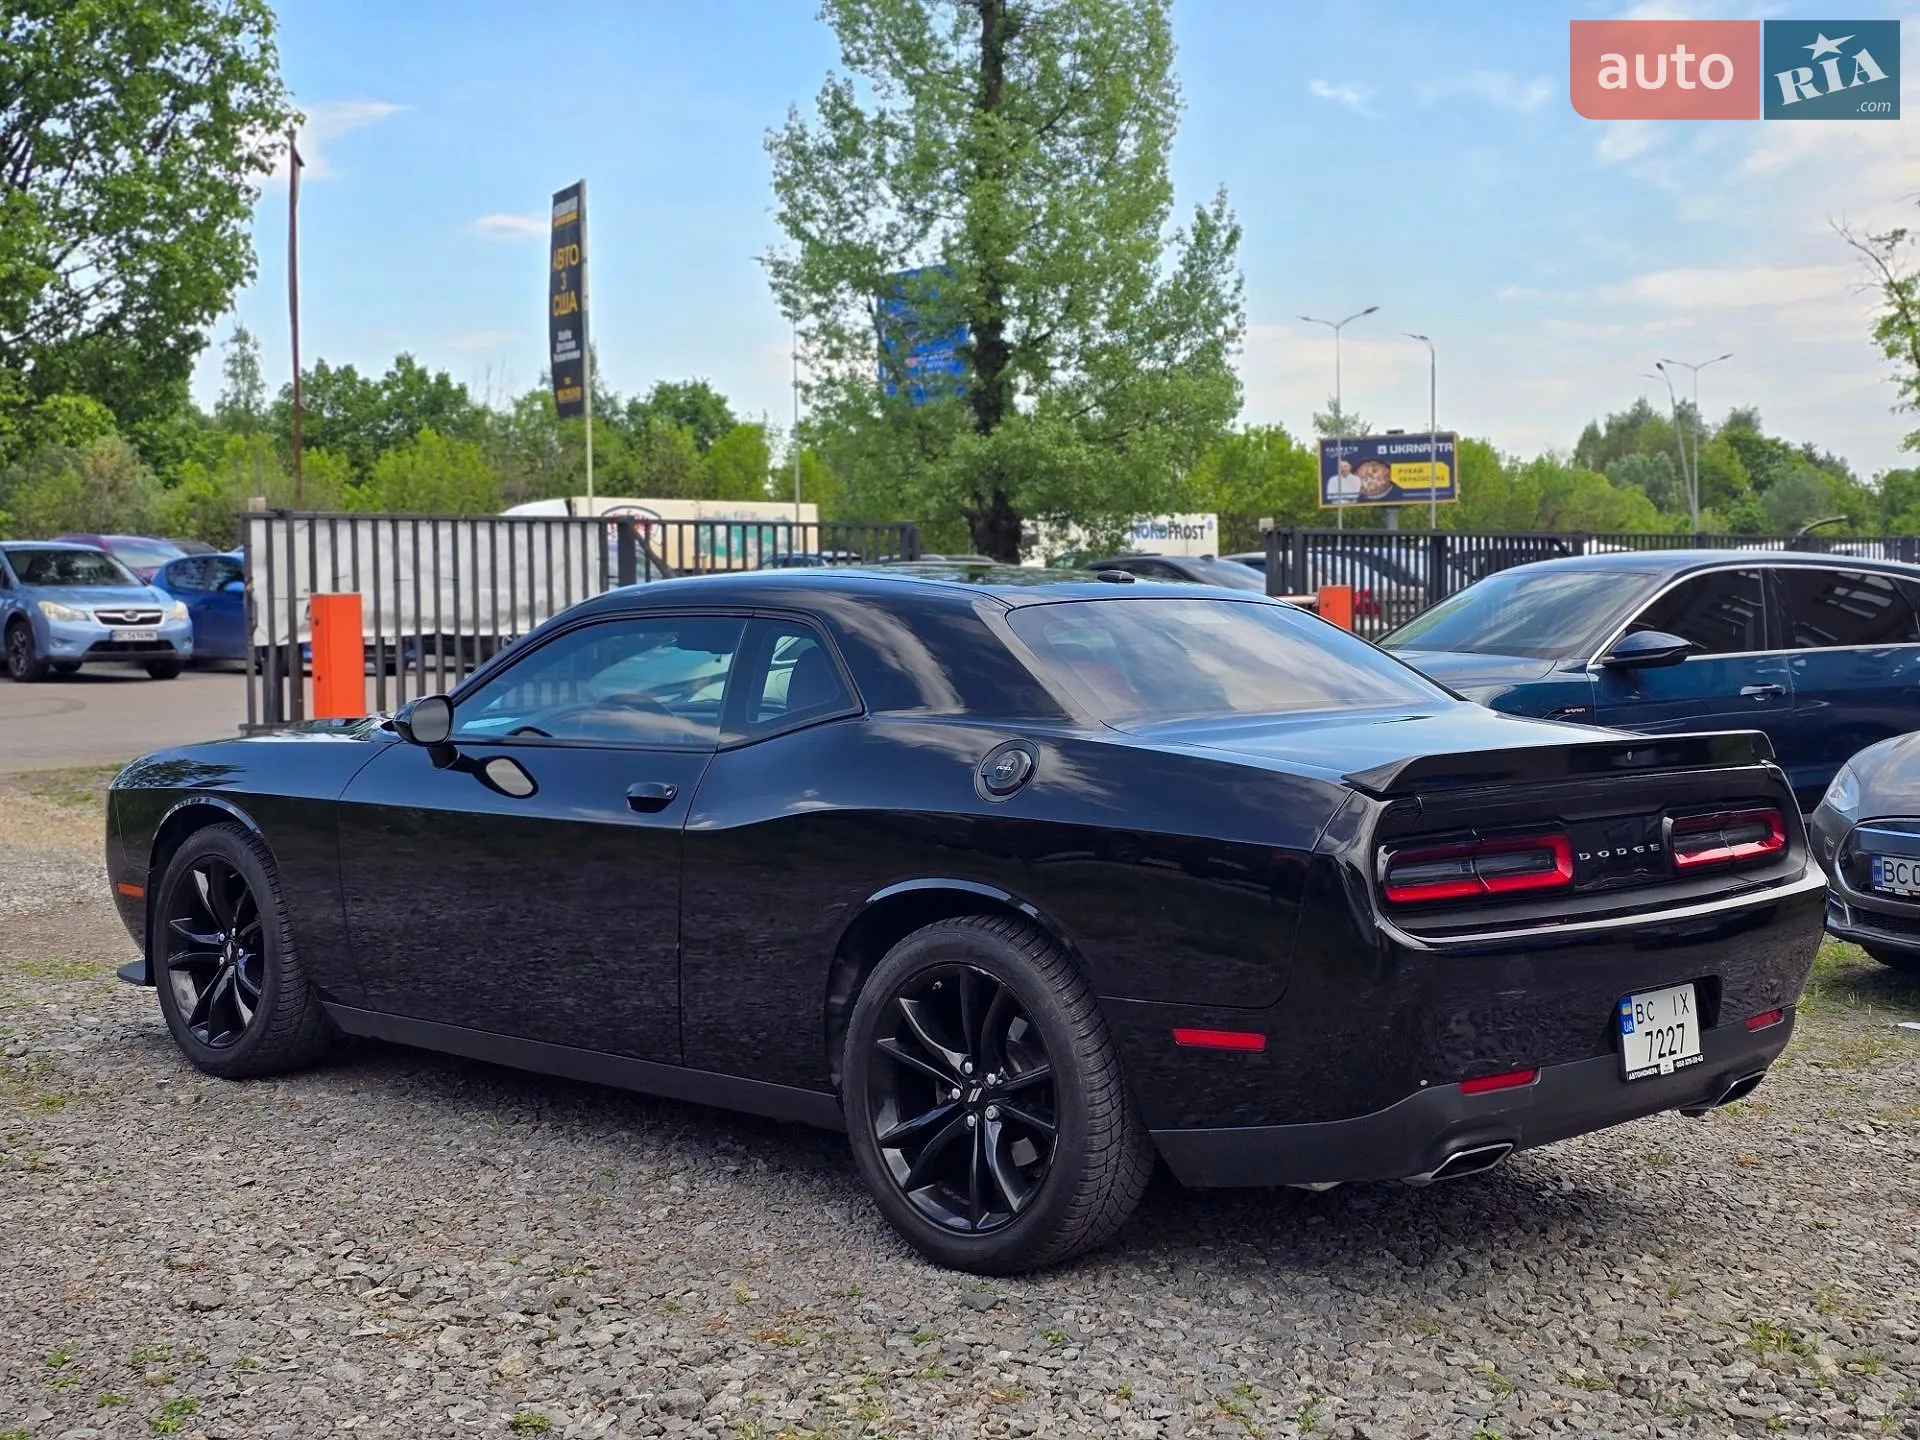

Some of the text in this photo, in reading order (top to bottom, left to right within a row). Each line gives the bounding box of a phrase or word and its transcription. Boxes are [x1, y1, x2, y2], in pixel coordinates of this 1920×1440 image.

[553, 291, 578, 317] США
[1131, 522, 1205, 540] NORDFROST
[1578, 843, 1661, 861] DODGE
[1636, 992, 1690, 1025] BC IX
[1623, 1020, 1634, 1033] UA
[1645, 1022, 1685, 1063] 7227
